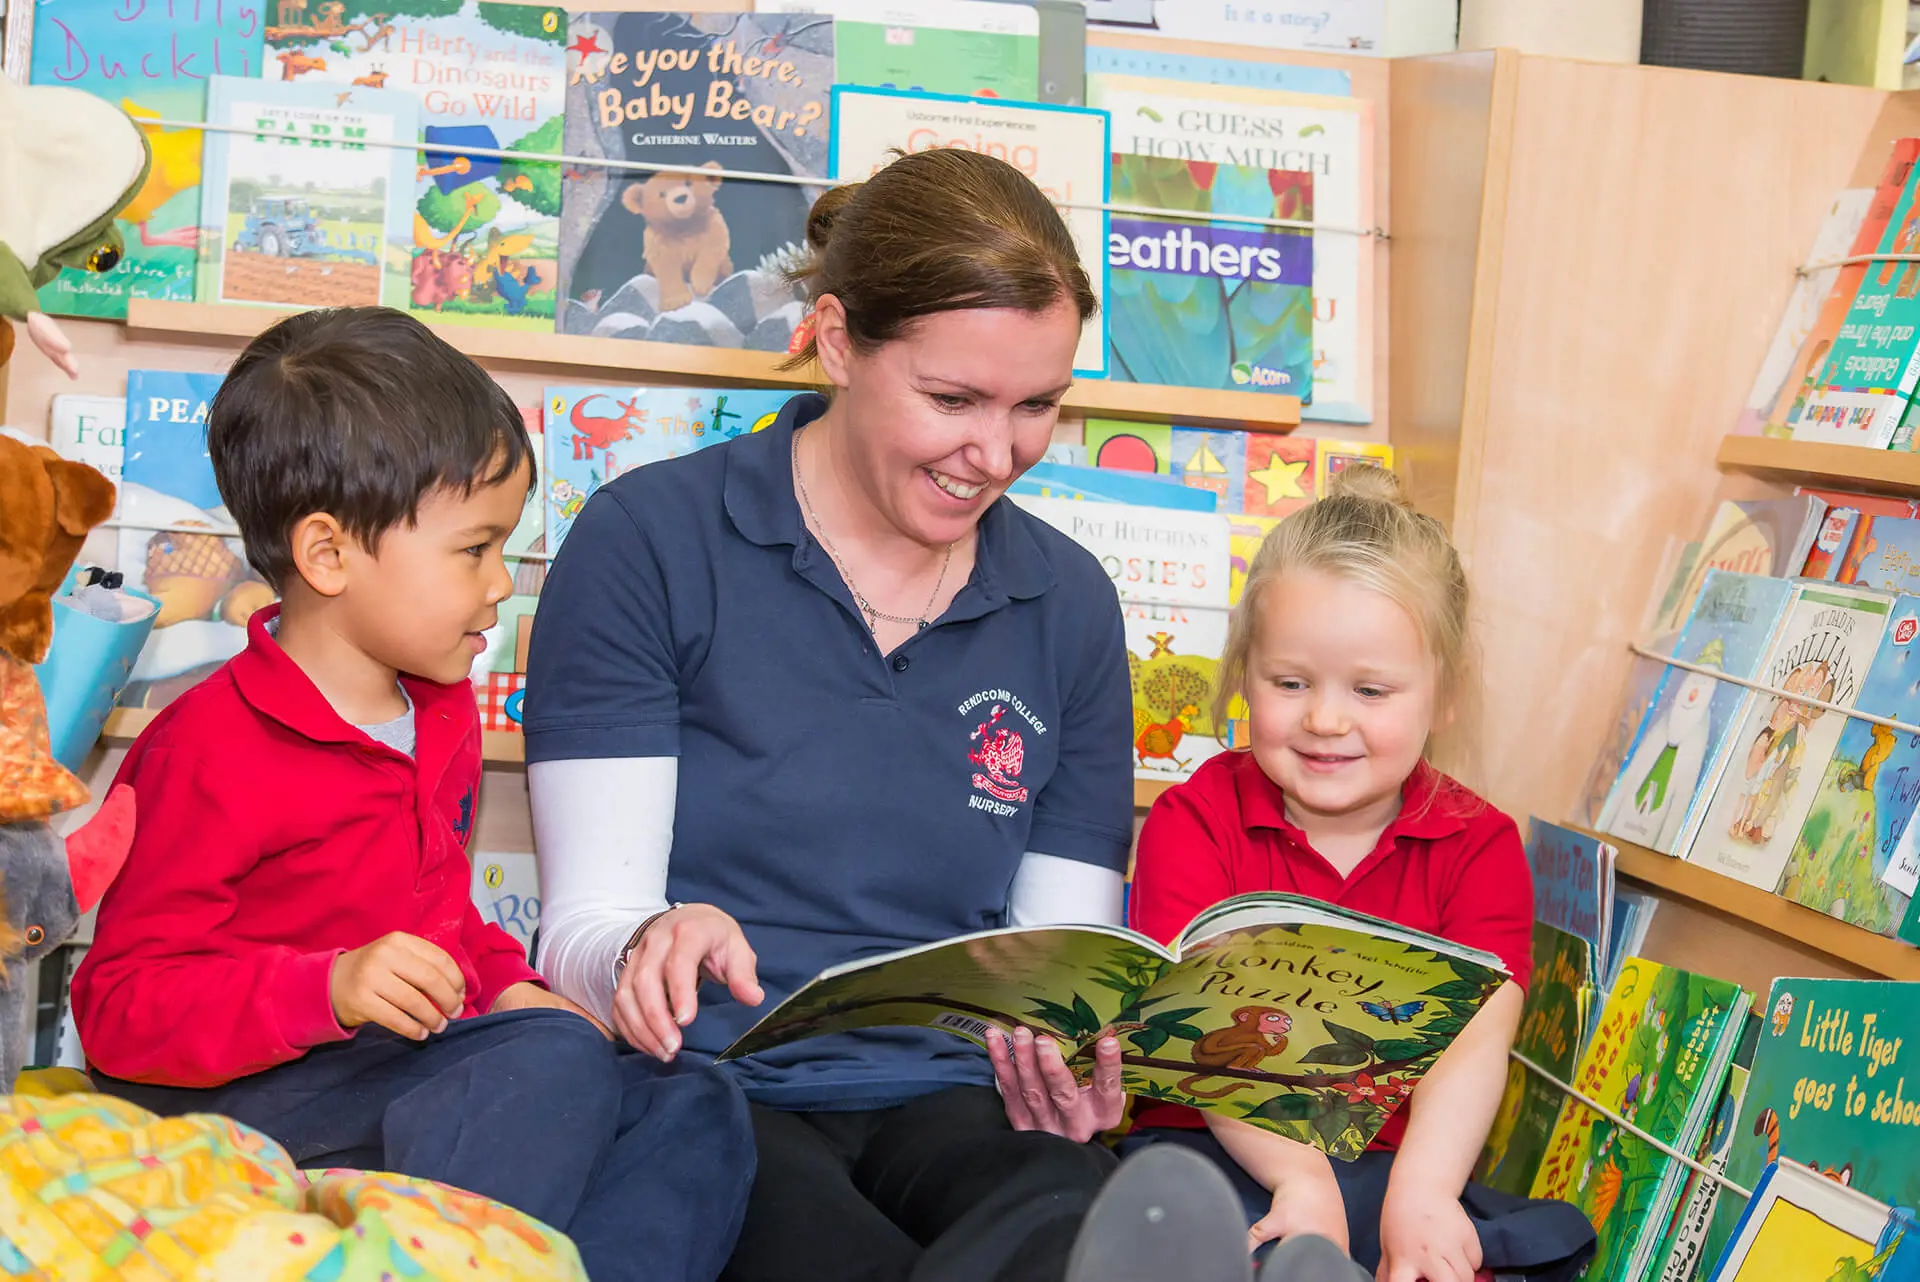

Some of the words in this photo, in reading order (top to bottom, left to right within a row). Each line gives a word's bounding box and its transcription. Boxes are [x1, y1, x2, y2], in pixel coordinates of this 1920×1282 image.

[1225, 4, 1239, 22] Is
[1246, 5, 1256, 23] it
[1262, 12, 1273, 23] a
[1280, 11, 1331, 34] story?
[400, 26, 480, 64] Harry
[484, 43, 518, 63] and
[523, 46, 552, 66] the
[412, 58, 551, 92] Dinosaurs
[633, 48, 700, 88] you
[707, 40, 802, 88] there,
[425, 89, 466, 117] Go
[473, 92, 536, 121] Wild
[599, 82, 695, 130] Baby
[704, 80, 823, 137] Bear?
[906, 111, 951, 124] Usborne
[976, 117, 1037, 132] Experiences
[254, 118, 368, 151] FARM
[631, 132, 701, 146] CATHERINE
[703, 132, 758, 146] WALTERS
[1178, 109, 1284, 139] GUESS
[1132, 135, 1213, 162] HOW
[1225, 145, 1331, 176] MUCH
[1251, 366, 1291, 386] Acorn
[657, 415, 705, 437] The
[1072, 516, 1105, 537] PAT
[1115, 520, 1209, 547] HUTCHINS
[1120, 590, 1189, 624] ALK
[1770, 632, 1854, 705] BRILLIANT
[958, 689, 1011, 716] RENDCOMB
[1011, 695, 1047, 735] COLLEGE
[968, 794, 1019, 817] NURSERY
[1194, 971, 1338, 1014] Puzzle
[1800, 1000, 1854, 1056] Little
[1858, 1013, 1903, 1078] Tiger
[1789, 1077, 1836, 1120] goes
[1844, 1075, 1867, 1117] to
